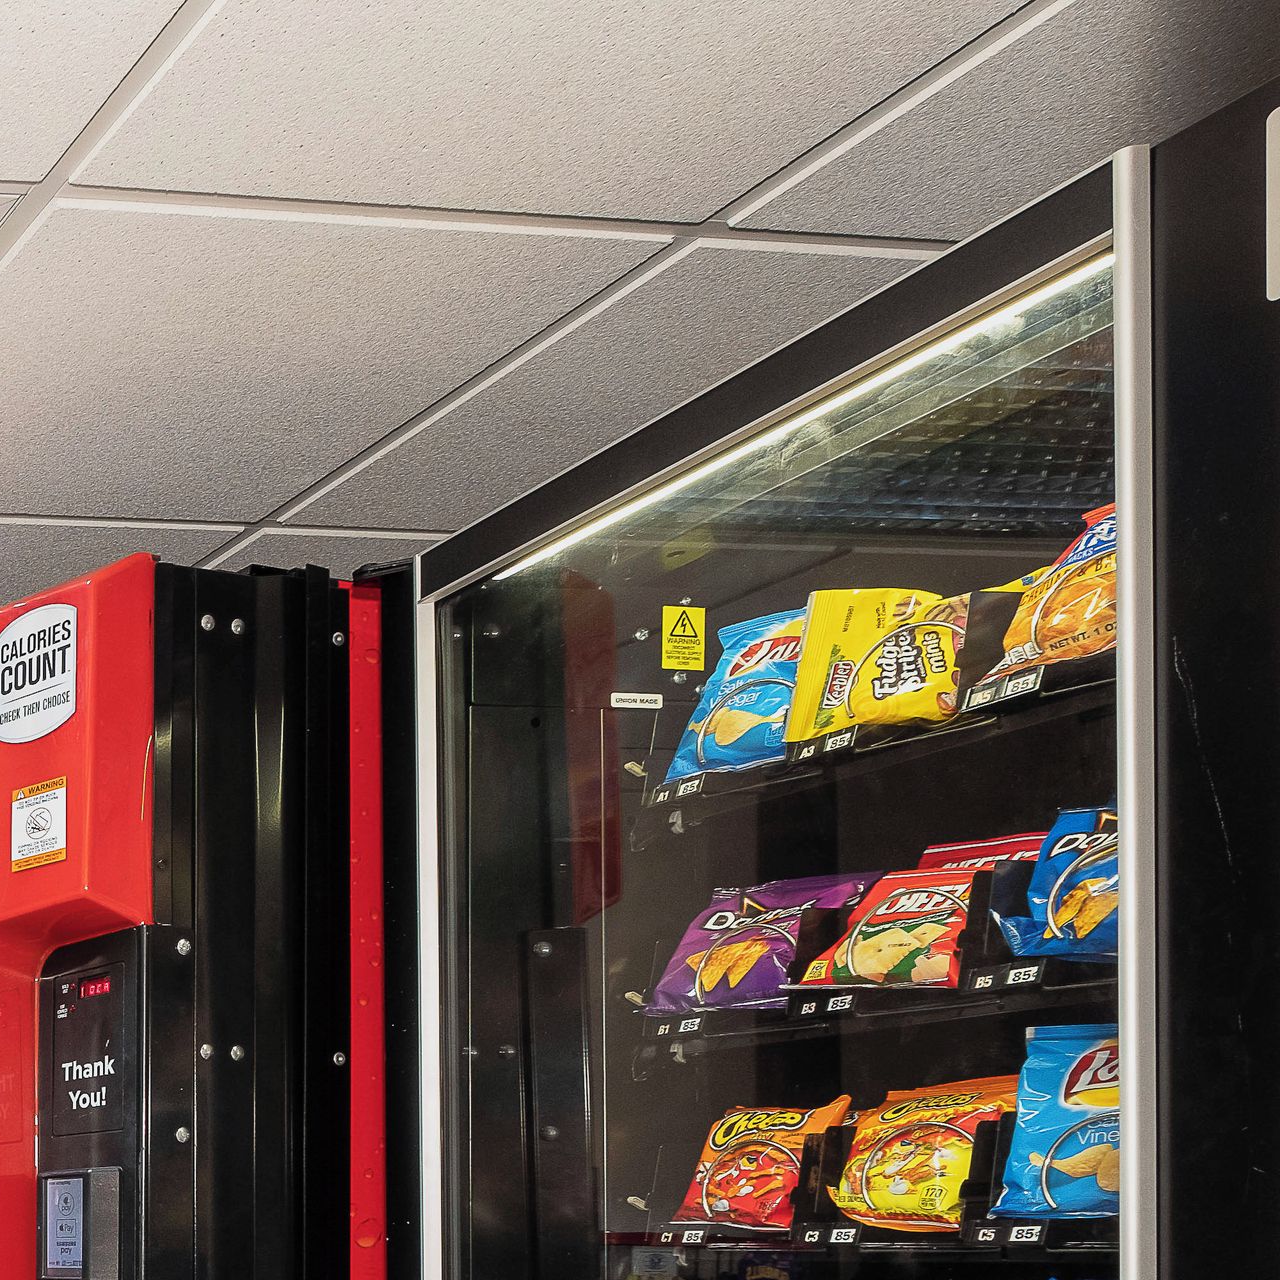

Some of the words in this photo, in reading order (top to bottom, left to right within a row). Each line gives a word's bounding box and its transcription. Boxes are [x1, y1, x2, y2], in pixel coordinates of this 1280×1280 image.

[0, 619, 71, 665] CALORIES
[666, 637, 701, 646] WARNING
[922, 631, 947, 673] minis
[0, 643, 71, 696] COUNT
[872, 636, 897, 700] Fudge
[718, 679, 743, 697] Salt
[823, 661, 853, 709] Keebler
[0, 706, 21, 726] CHECK
[23, 700, 41, 719] THEN
[42, 690, 71, 712] CHOOSE
[798, 745, 816, 760] A3
[28, 778, 64, 795] WARNING
[655, 790, 669, 803] A1
[974, 974, 993, 989] B5
[801, 1002, 816, 1015] B3
[657, 1024, 670, 1036] B1
[61, 1054, 116, 1082] Thank
[68, 1086, 107, 1110] You!
[880, 1092, 983, 1123] Cheetos
[64, 1223, 74, 1234] Pay
[804, 1230, 819, 1242] C3
[977, 1228, 997, 1241] C5
[660, 1231, 673, 1243] C1
[60, 1247, 72, 1255] pay
